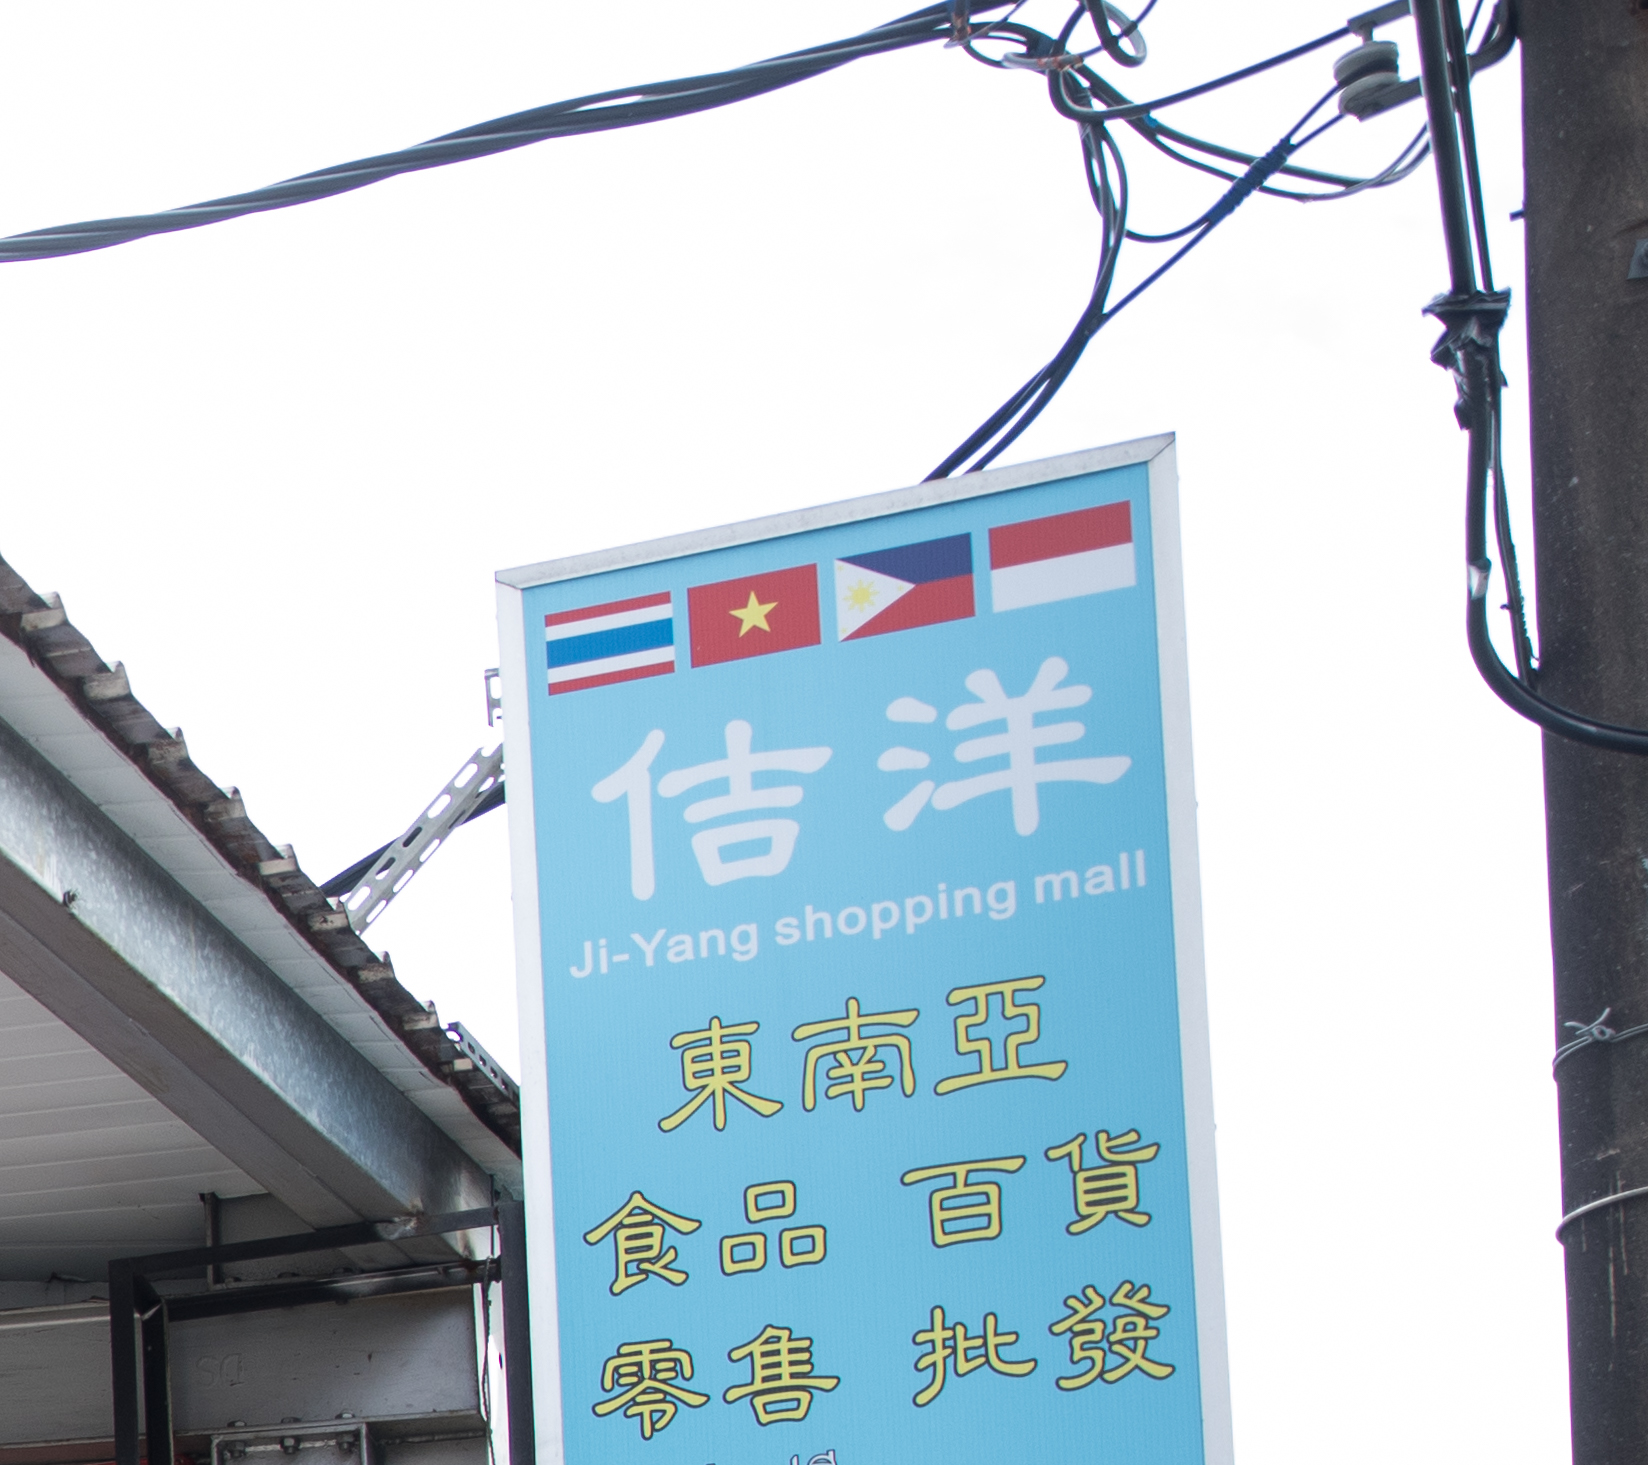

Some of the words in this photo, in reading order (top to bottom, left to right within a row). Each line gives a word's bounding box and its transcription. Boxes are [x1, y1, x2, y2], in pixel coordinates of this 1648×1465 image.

[590, 655, 1133, 902] 佶洋
[570, 921, 761, 980] Ji-Yang
[774, 877, 1018, 947] shopping
[1034, 849, 1147, 904] mall
[658, 974, 1068, 1133] 東南亞
[584, 1179, 828, 1297] 食品
[902, 1129, 1161, 1249] 百貨
[591, 1324, 841, 1441] 零售
[912, 1279, 1176, 1408] 批發
